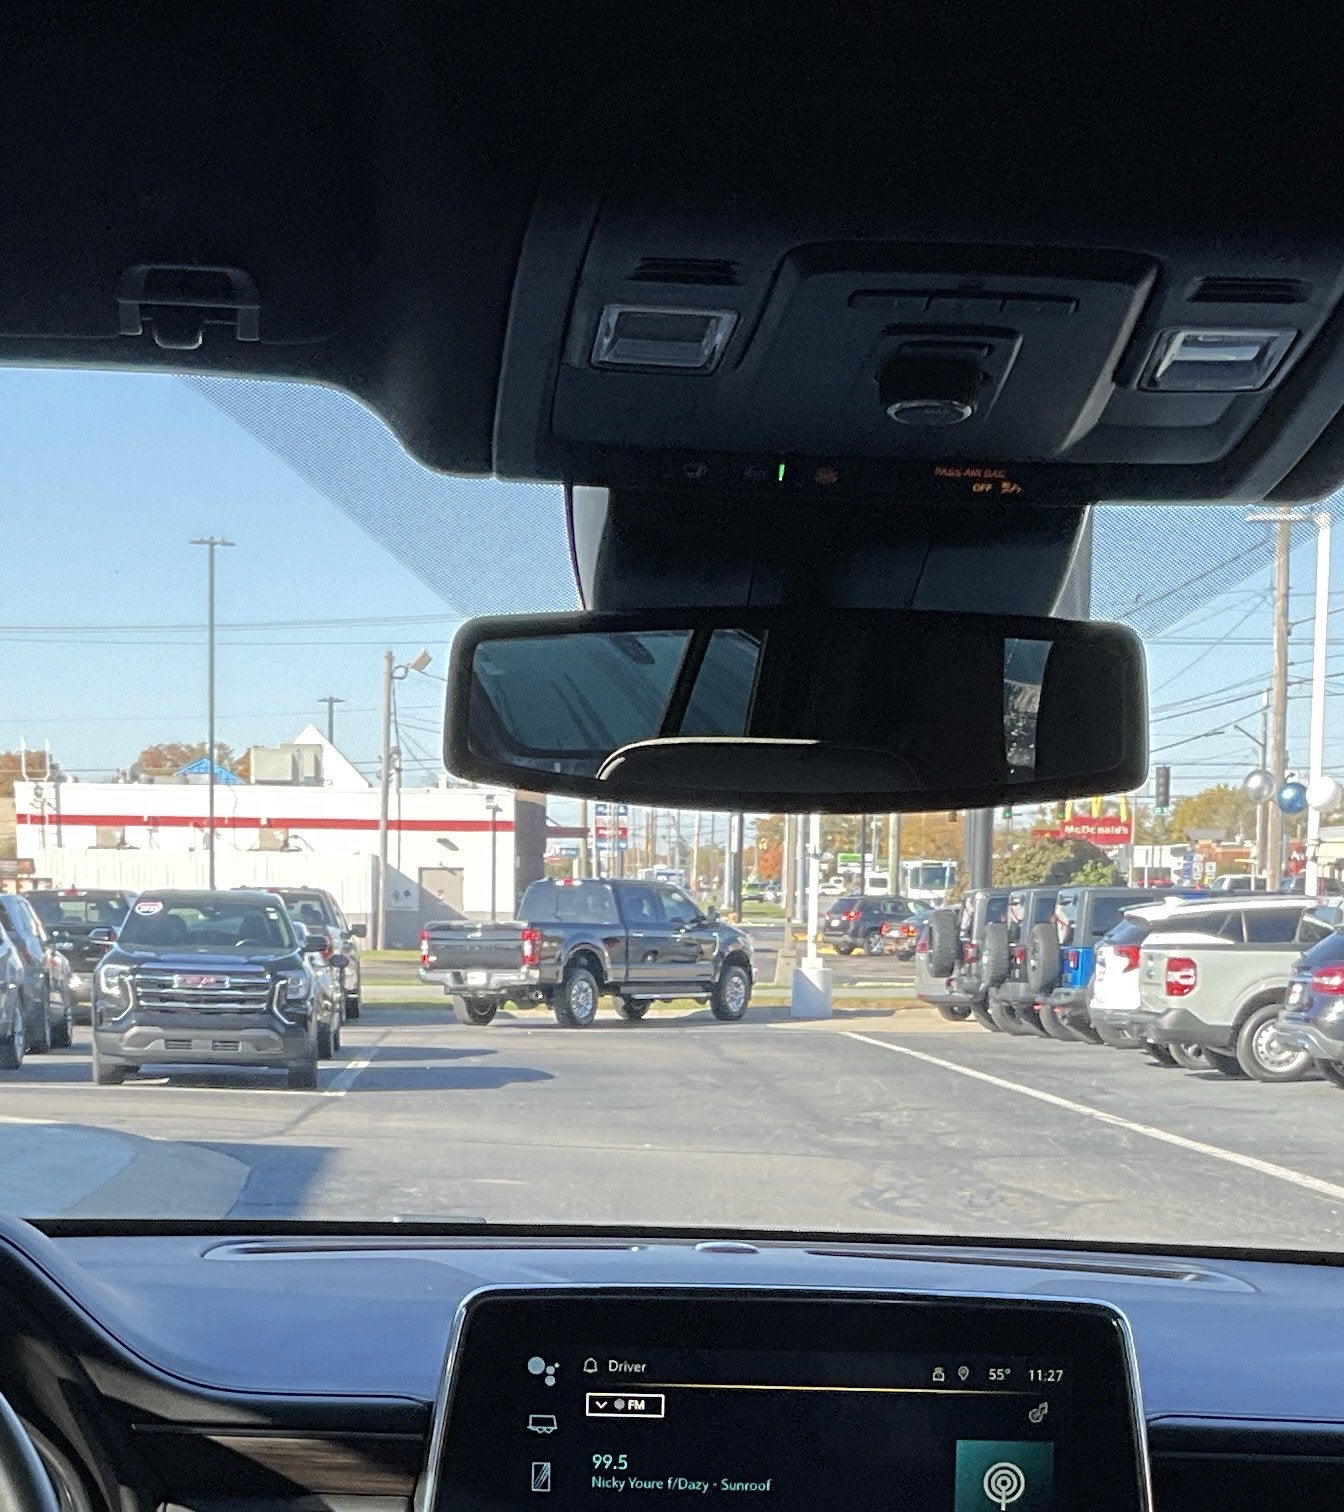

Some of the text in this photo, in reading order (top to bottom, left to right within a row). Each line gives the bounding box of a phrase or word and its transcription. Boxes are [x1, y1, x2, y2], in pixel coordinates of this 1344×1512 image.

[608, 1359, 647, 1373] Driver
[1028, 1369, 1064, 1382] 11:27
[627, 1399, 646, 1411] FM
[592, 1453, 628, 1470] 99.5
[591, 1475, 626, 1492] Nicky
[628, 1476, 664, 1490] Youre
[667, 1476, 709, 1494] f/Dazy
[720, 1478, 773, 1491] Sunroof
